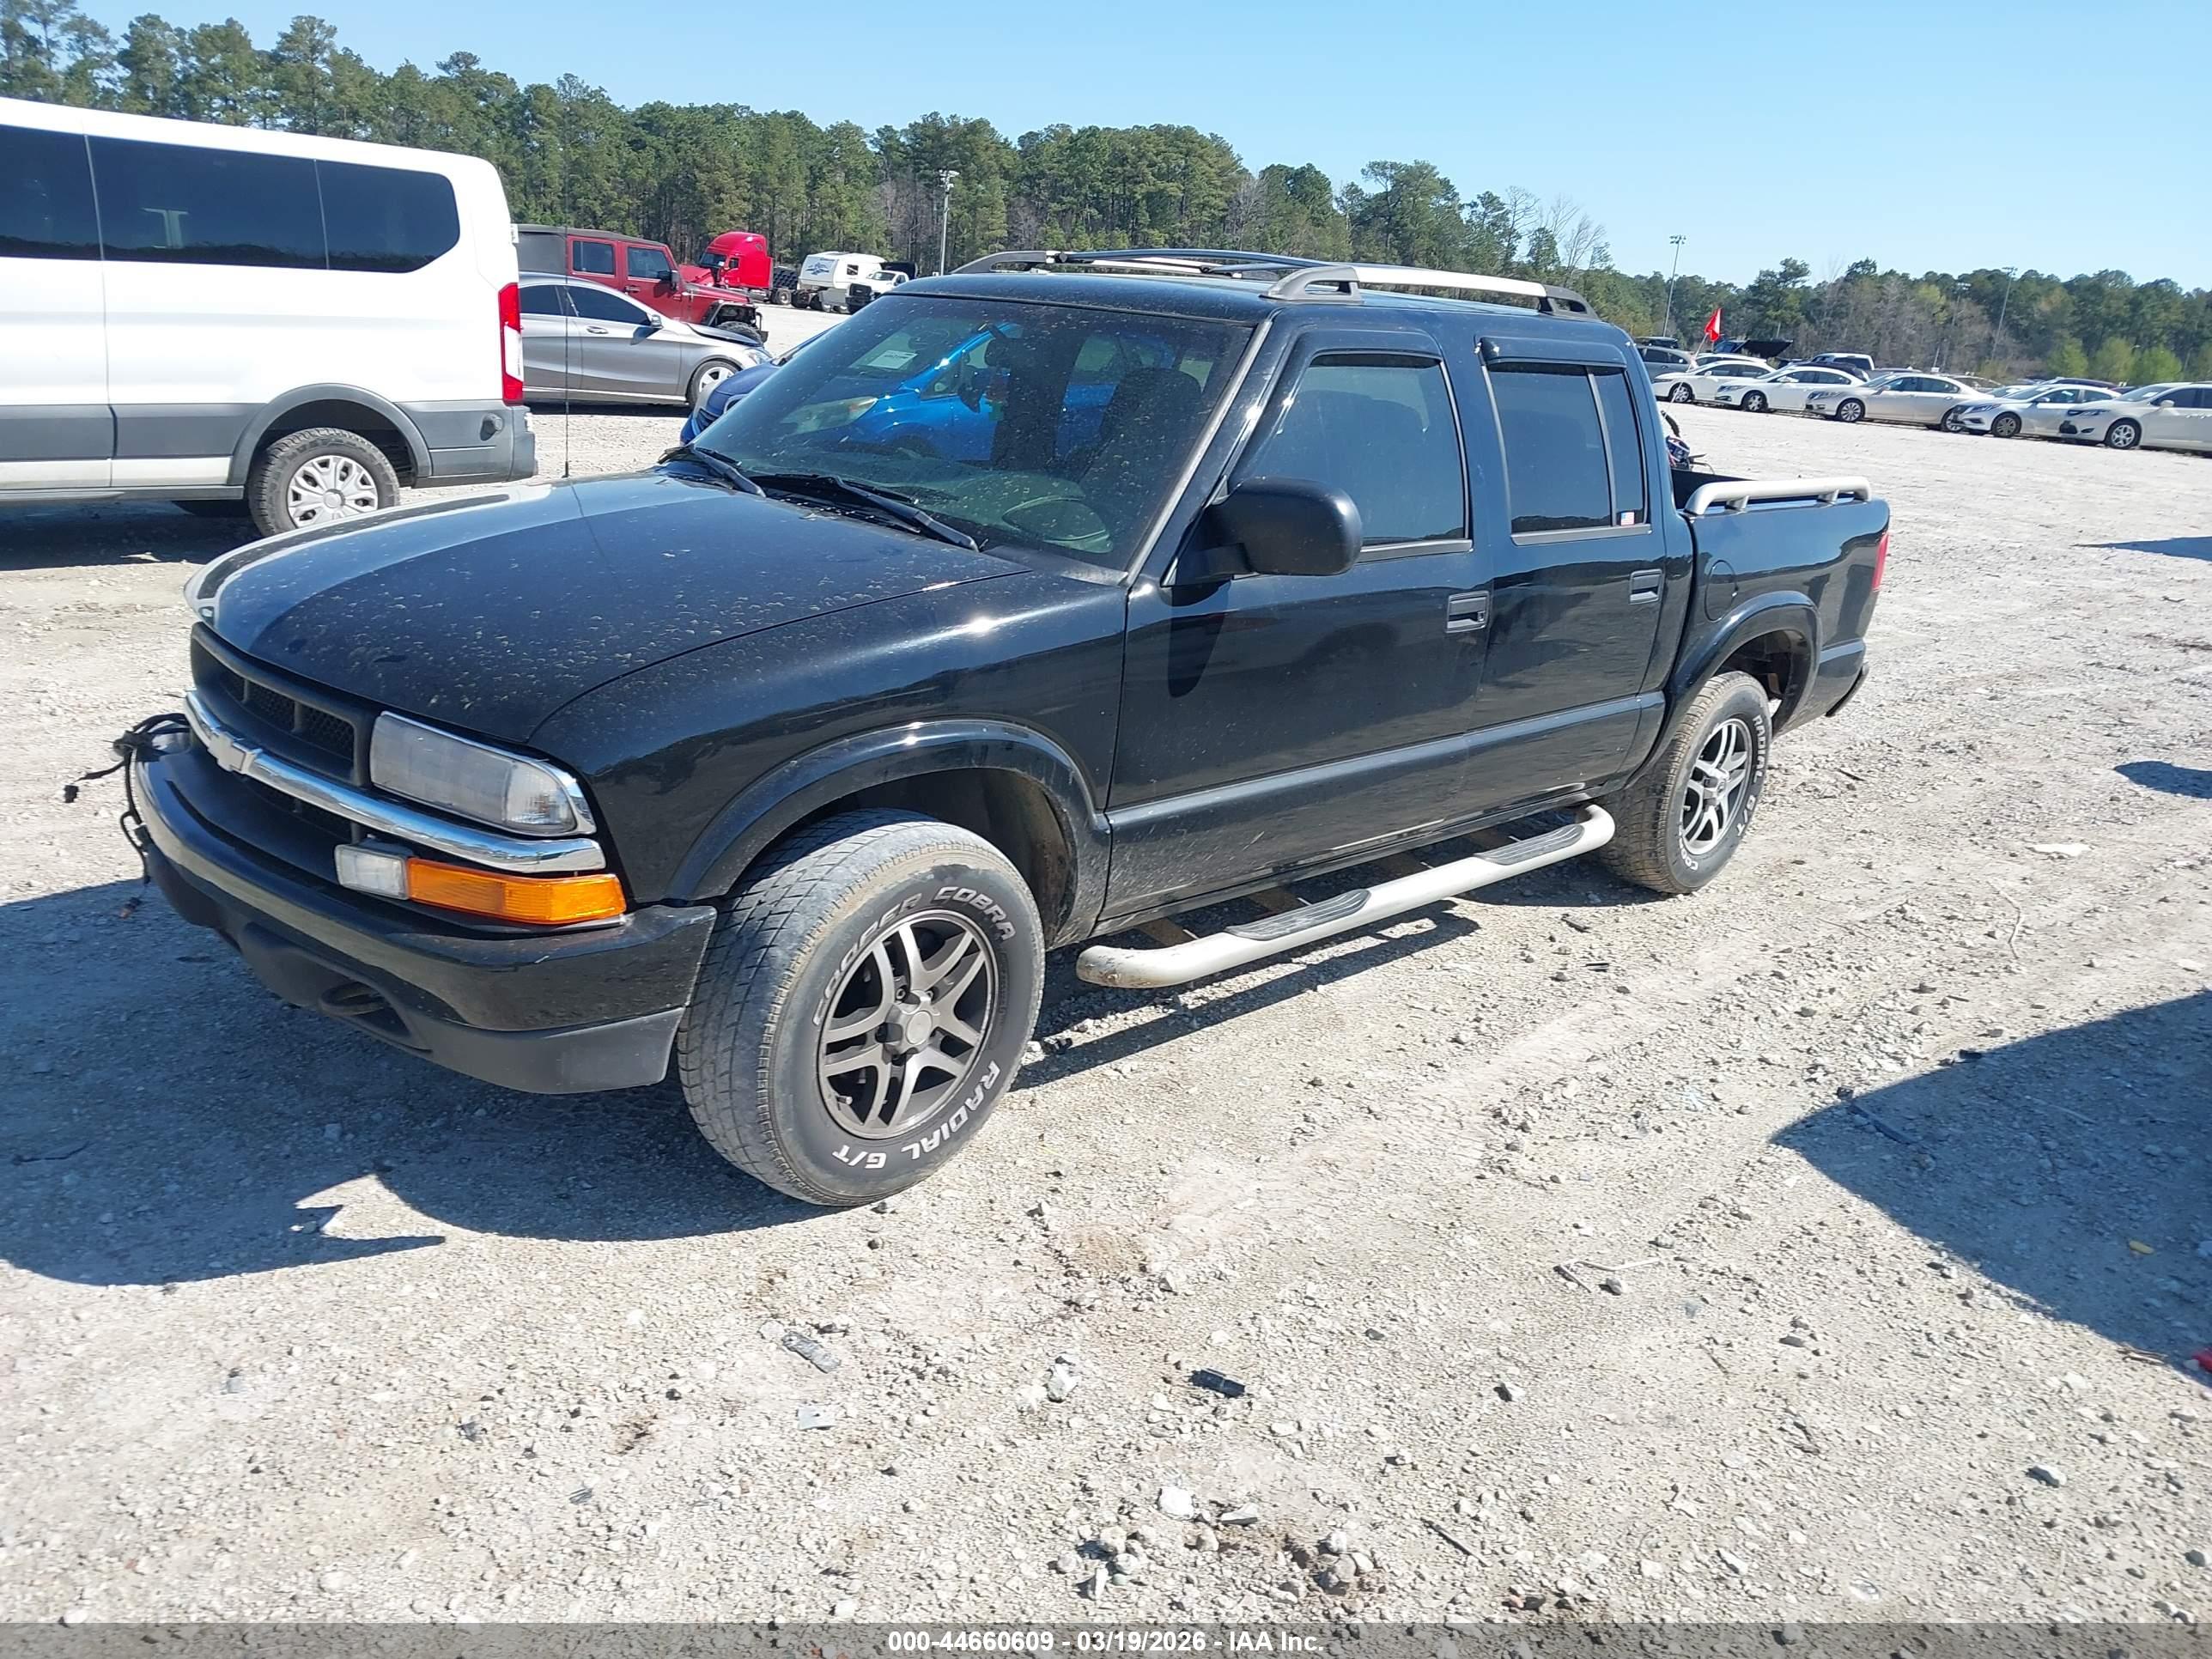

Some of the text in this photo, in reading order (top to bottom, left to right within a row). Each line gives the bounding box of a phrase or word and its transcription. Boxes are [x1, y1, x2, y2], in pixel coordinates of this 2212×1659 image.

[1752, 714, 1766, 783] RADIAL
[933, 886, 1017, 941] COBRA
[831, 1060, 1000, 1169] RADIAL G/T
